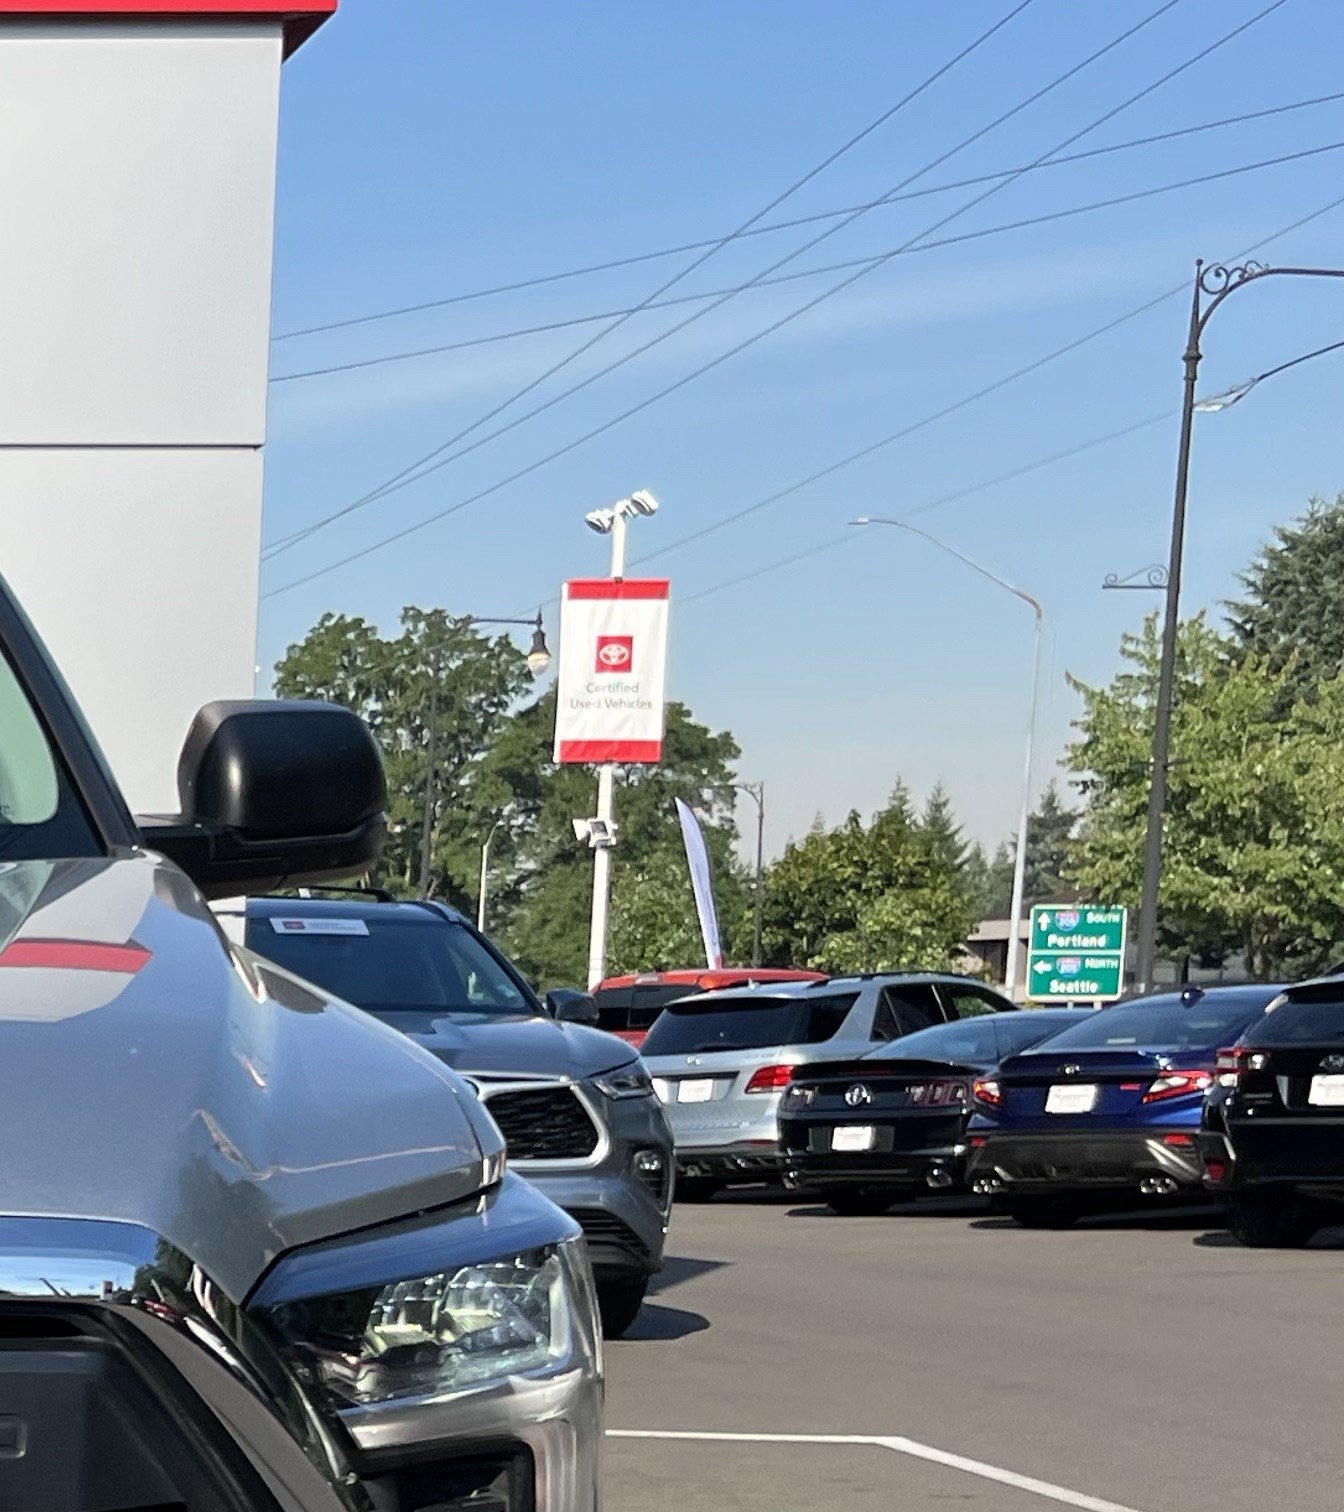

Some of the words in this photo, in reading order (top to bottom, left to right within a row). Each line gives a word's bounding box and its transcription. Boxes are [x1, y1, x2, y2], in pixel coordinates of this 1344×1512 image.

[586, 682, 639, 694] Certified
[570, 699, 601, 709] Used
[604, 699, 652, 709] Vehicles
[1047, 934, 1107, 948] Portland
[1049, 979, 1099, 993] Seattle
